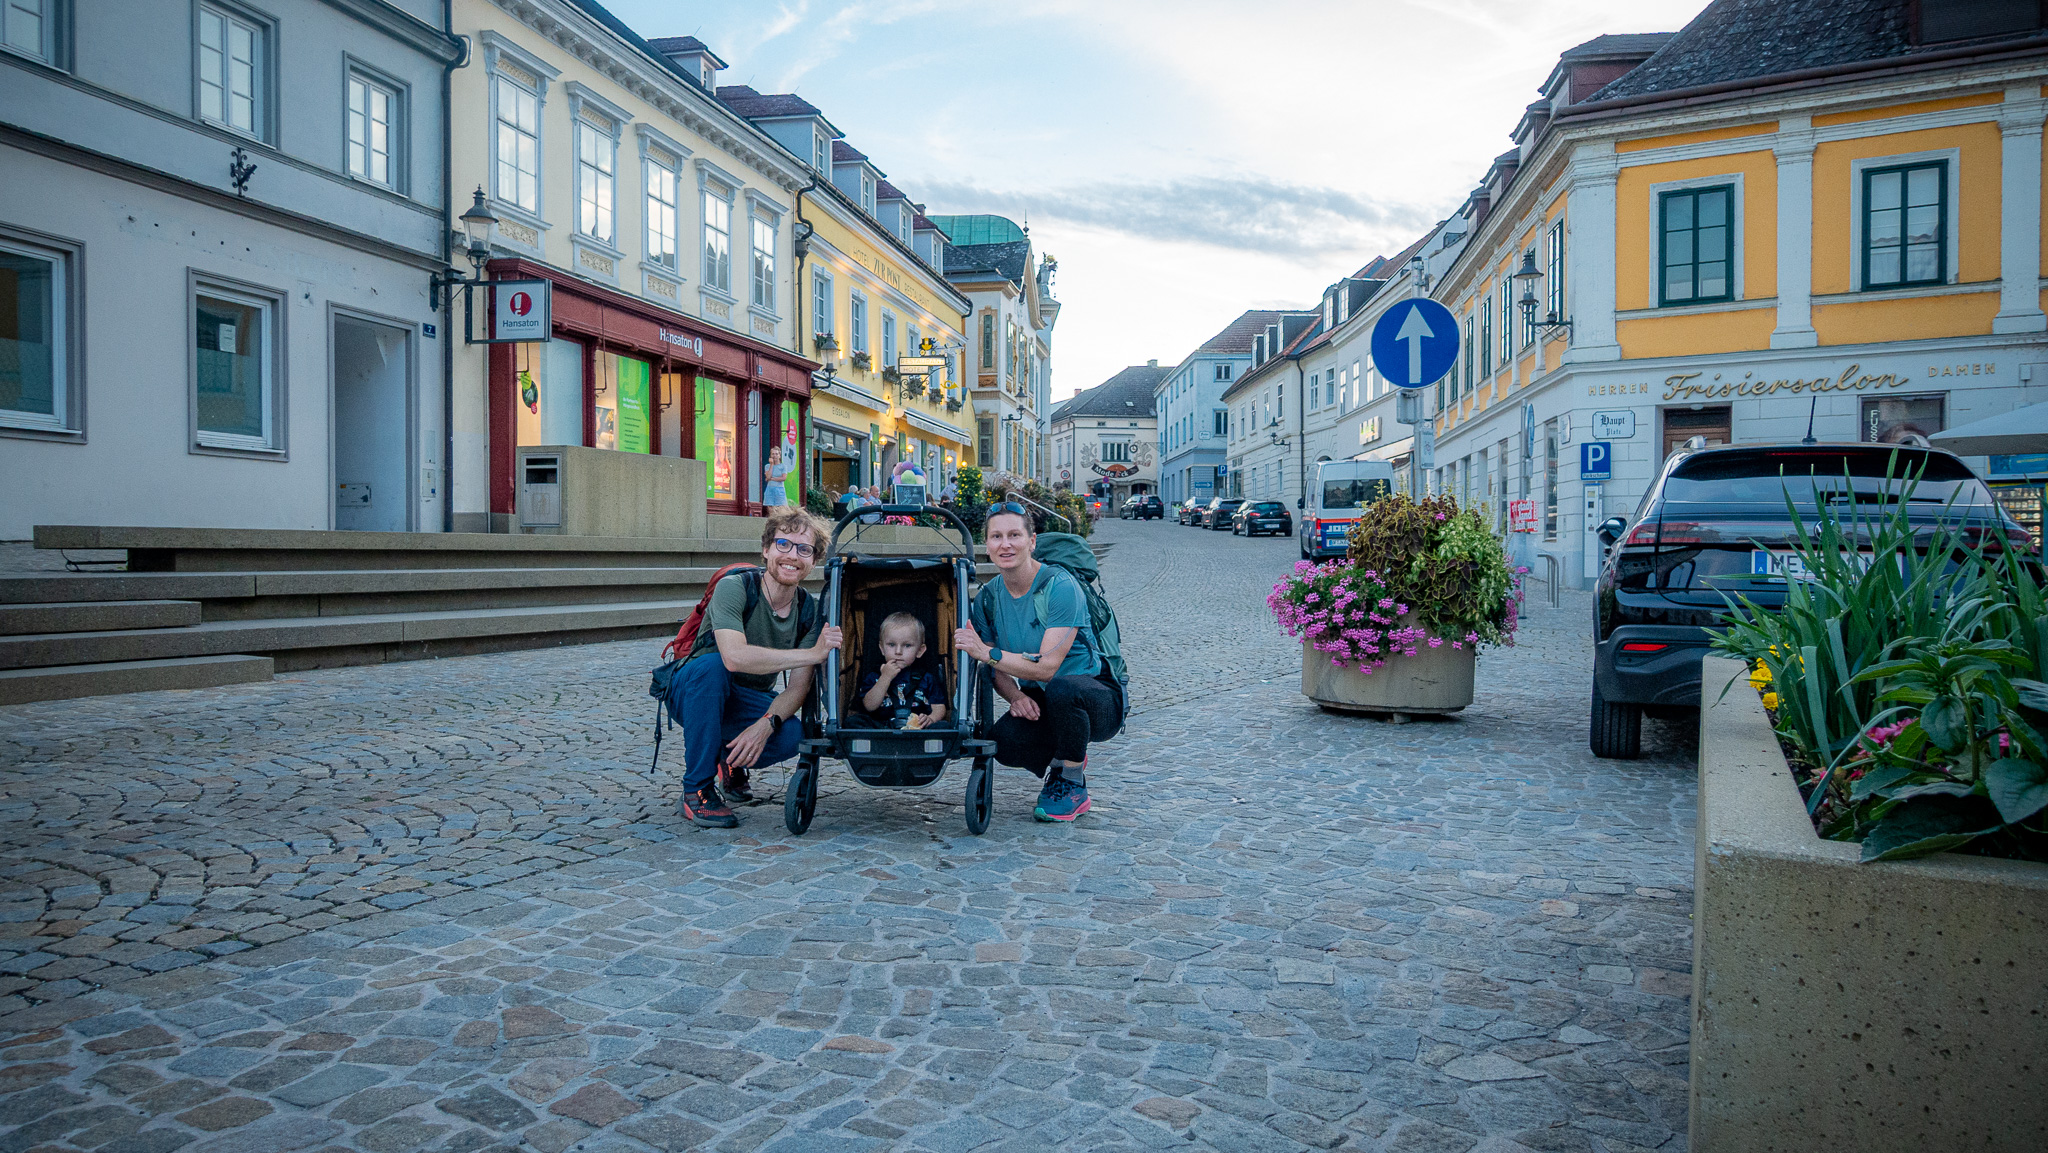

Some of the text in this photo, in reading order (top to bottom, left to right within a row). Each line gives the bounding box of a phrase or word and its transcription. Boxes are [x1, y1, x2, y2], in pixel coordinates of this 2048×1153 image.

[502, 319, 539, 327] Hansaton
[1928, 363, 1996, 377] DAMEN
[1663, 363, 1909, 400] Frisiersalon
[1588, 383, 1648, 396] HERREN
[1600, 414, 1625, 426] Haupt
[1588, 444, 1605, 471] P
[1094, 466, 1114, 478] Mode
[1220, 465, 1226, 474] P
